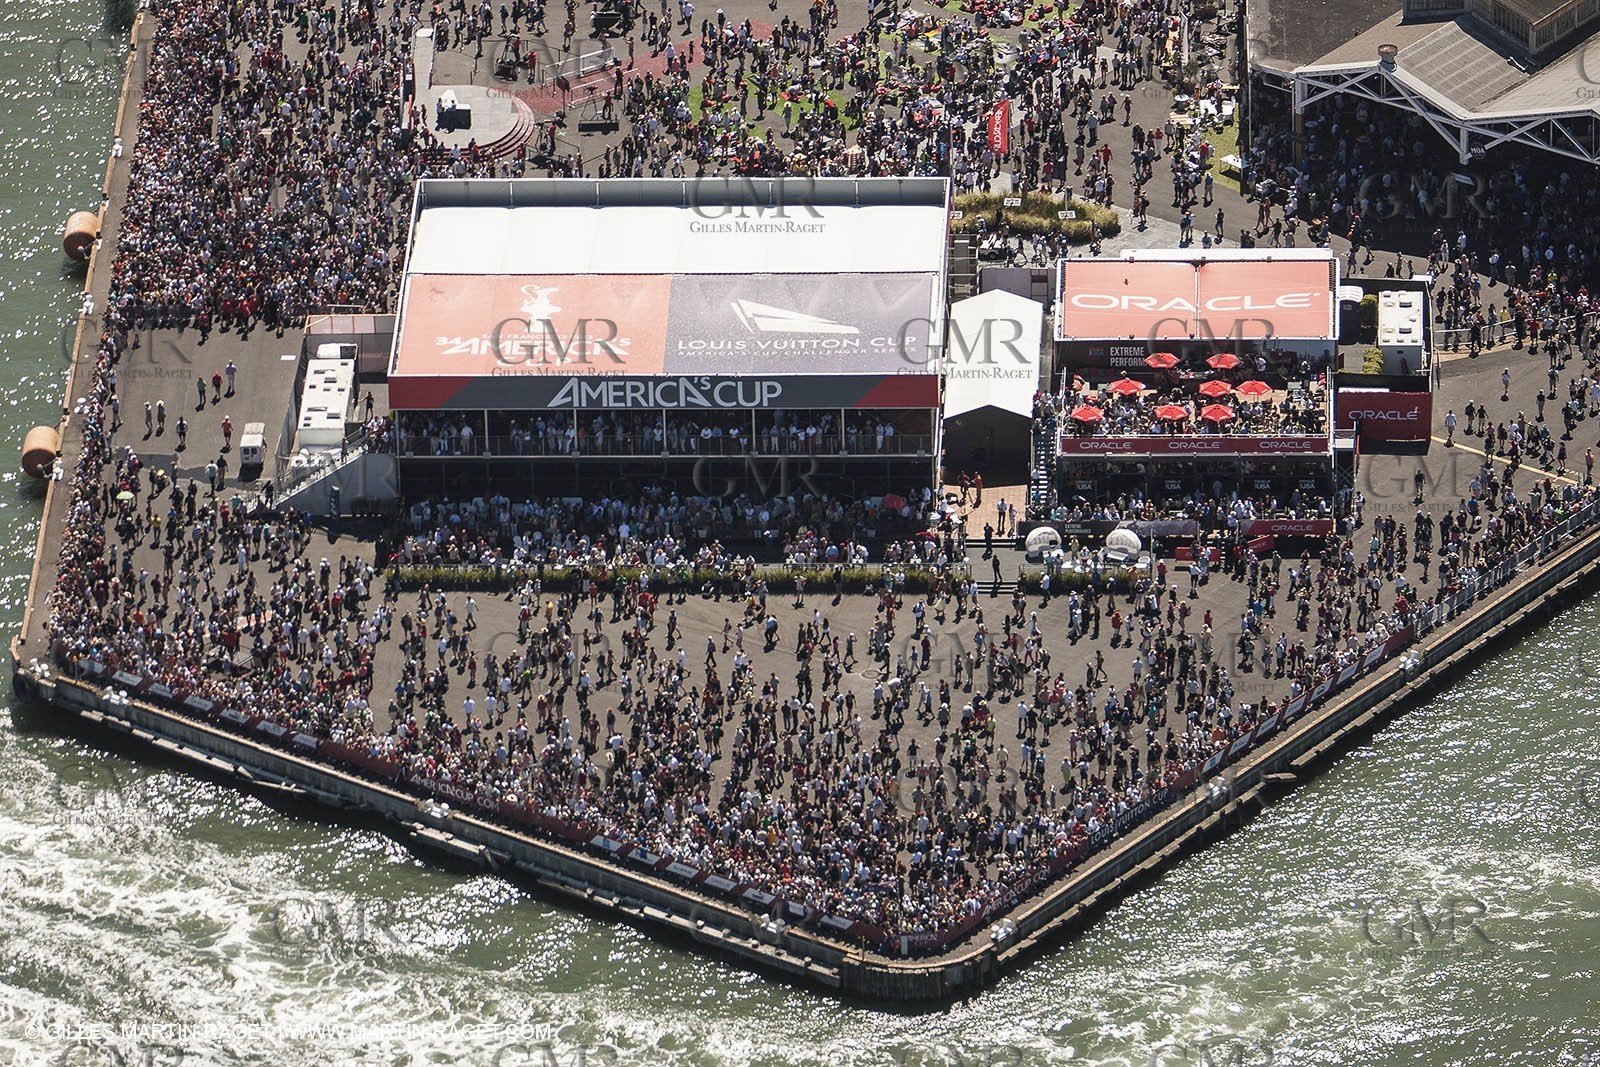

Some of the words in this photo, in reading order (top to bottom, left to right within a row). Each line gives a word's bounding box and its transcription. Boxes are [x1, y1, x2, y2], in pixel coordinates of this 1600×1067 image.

[1071, 292, 1316, 312] ORACLE
[677, 340, 747, 350] LOUIS
[756, 338, 860, 350] VUITTON
[870, 336, 917, 346] CUP
[1110, 346, 1145, 356] EXTREME
[547, 376, 712, 407] AMERICA'S
[713, 382, 783, 407] CUP
[1348, 410, 1418, 420] ORACLE
[1080, 441, 1132, 449] ORACLE
[1169, 441, 1221, 449] ORACLE
[1259, 441, 1312, 449] ORACLE
[1271, 524, 1314, 532] ORACLE
[1091, 825, 1114, 844] LOUIS
[1152, 788, 1169, 804] CUP
